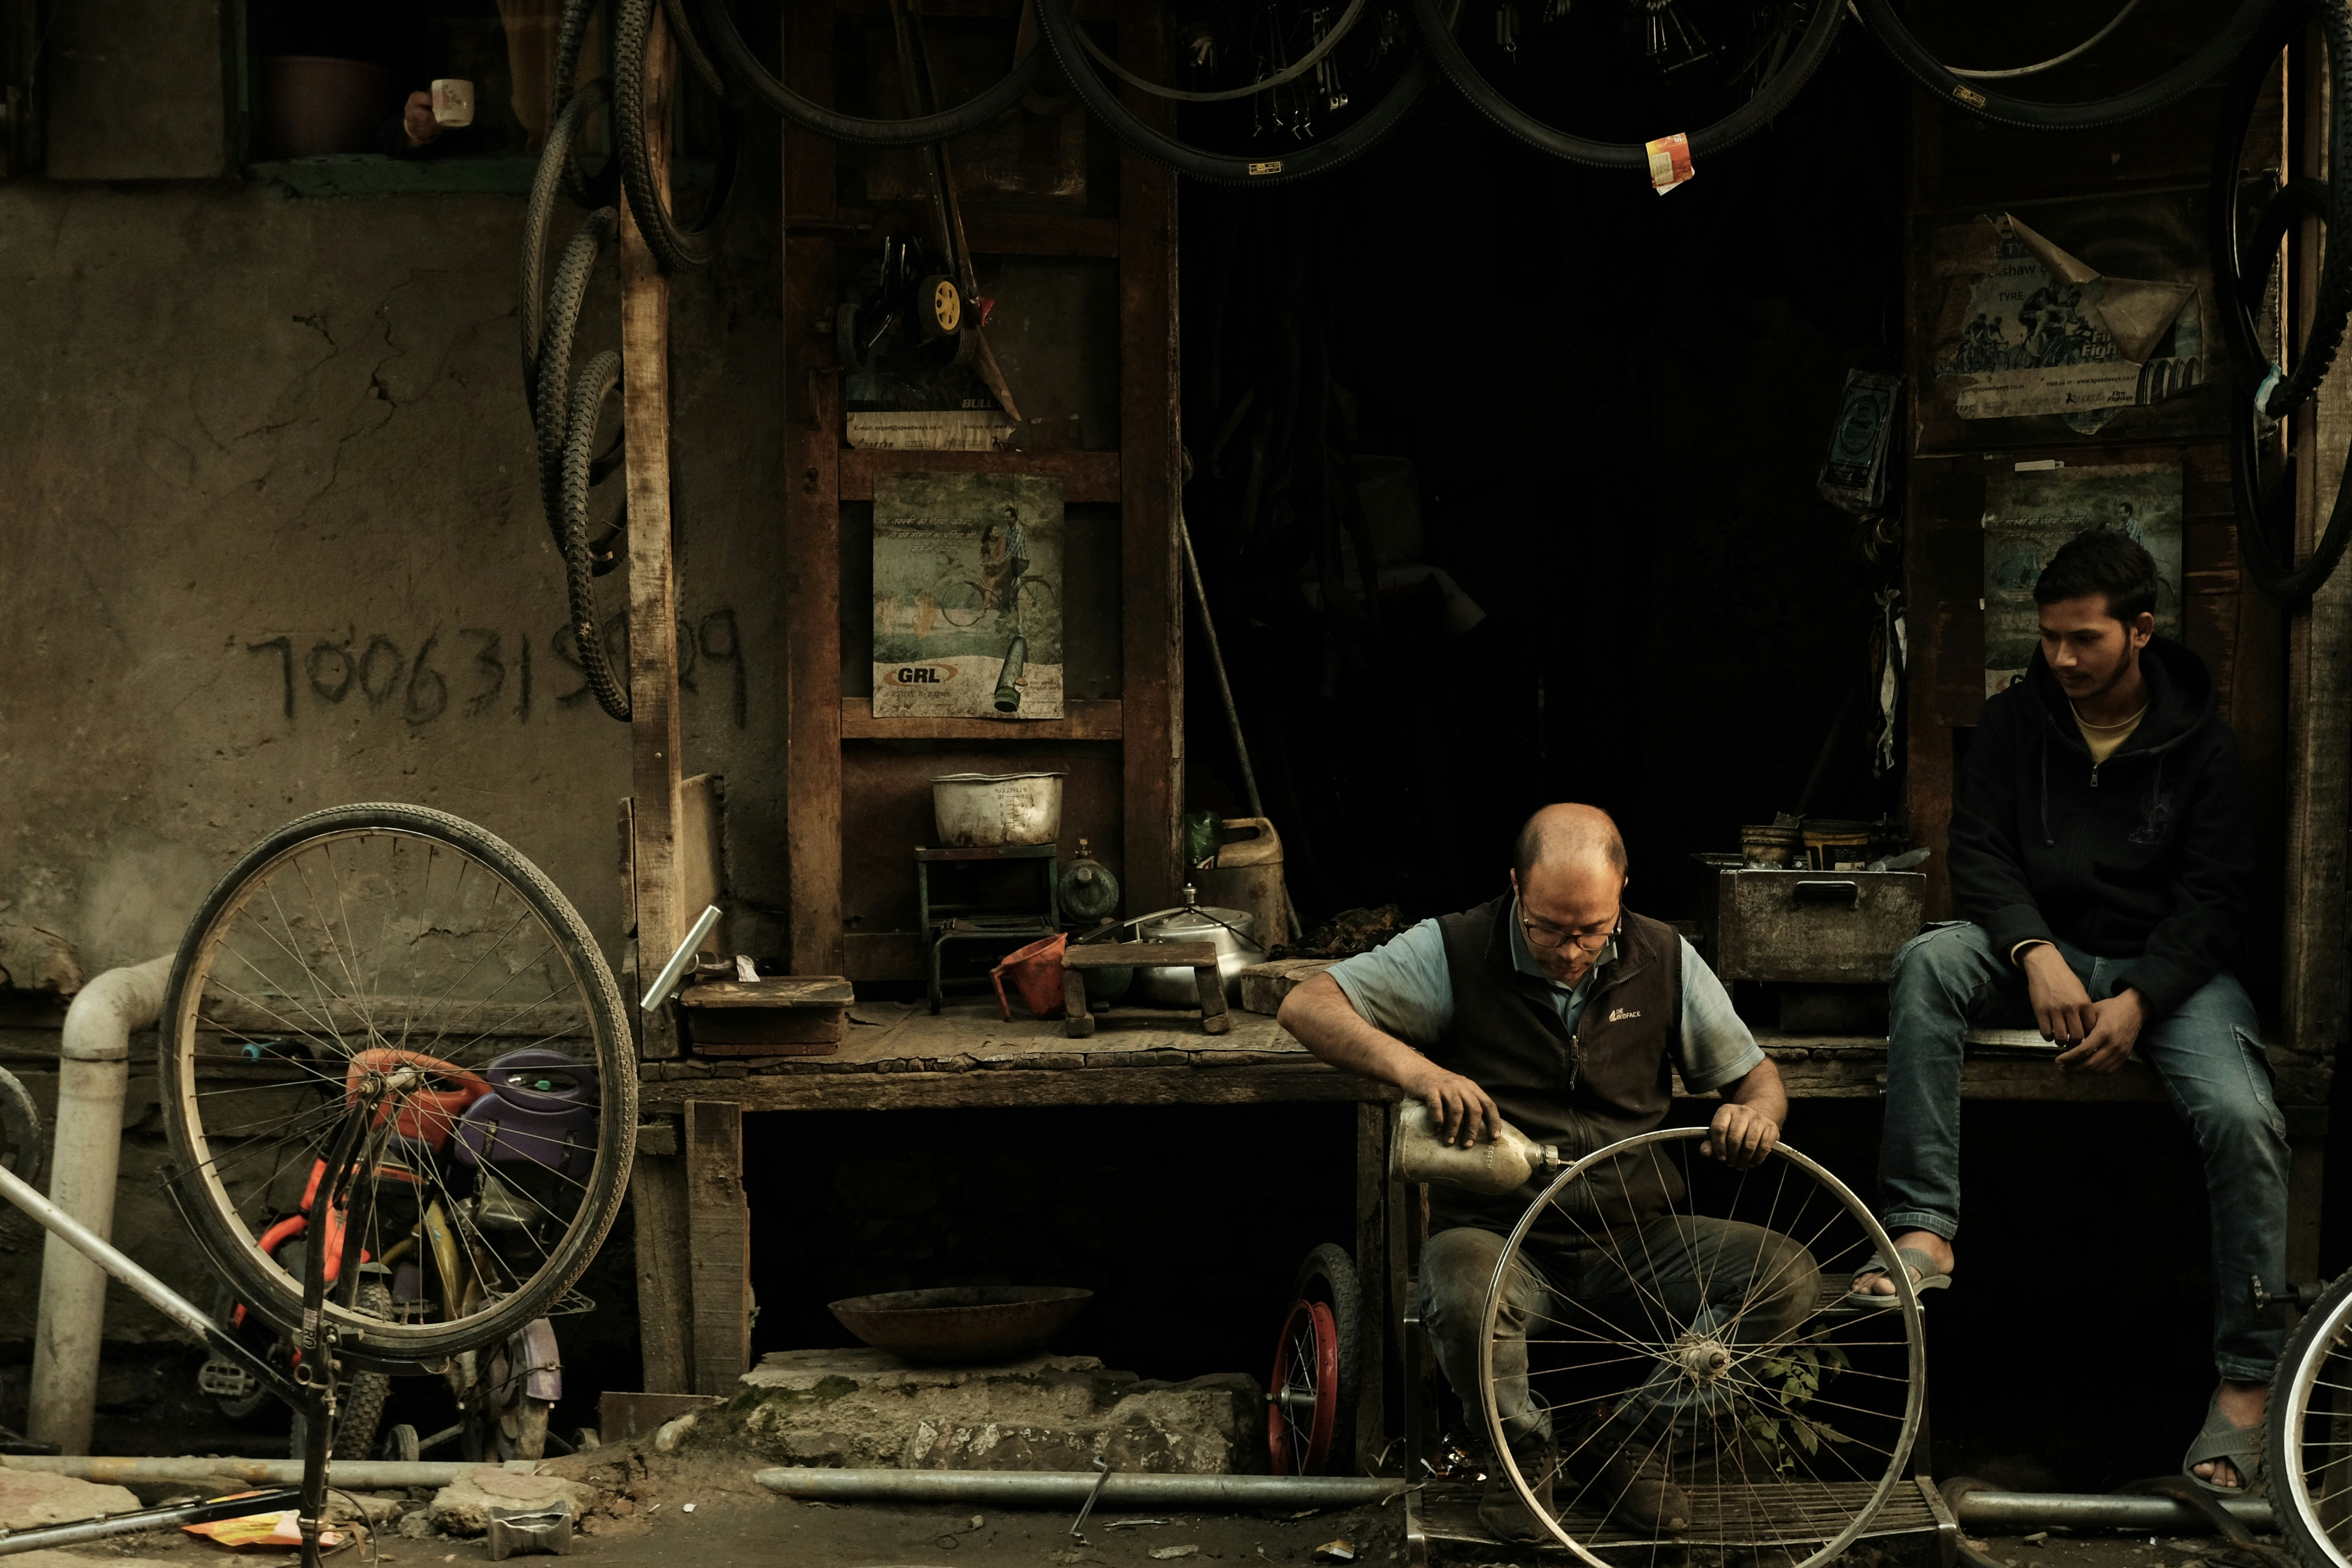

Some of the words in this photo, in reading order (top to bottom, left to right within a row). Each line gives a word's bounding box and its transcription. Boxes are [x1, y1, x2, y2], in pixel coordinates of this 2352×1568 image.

[2006, 243, 2028, 255] TY
[1998, 291, 2023, 302] TYRE
[2081, 342, 2118, 359] Figh
[2077, 376, 2136, 384] www.speedways.co.in
[962, 398, 993, 408] BULL
[898, 668, 940, 683] GRL
